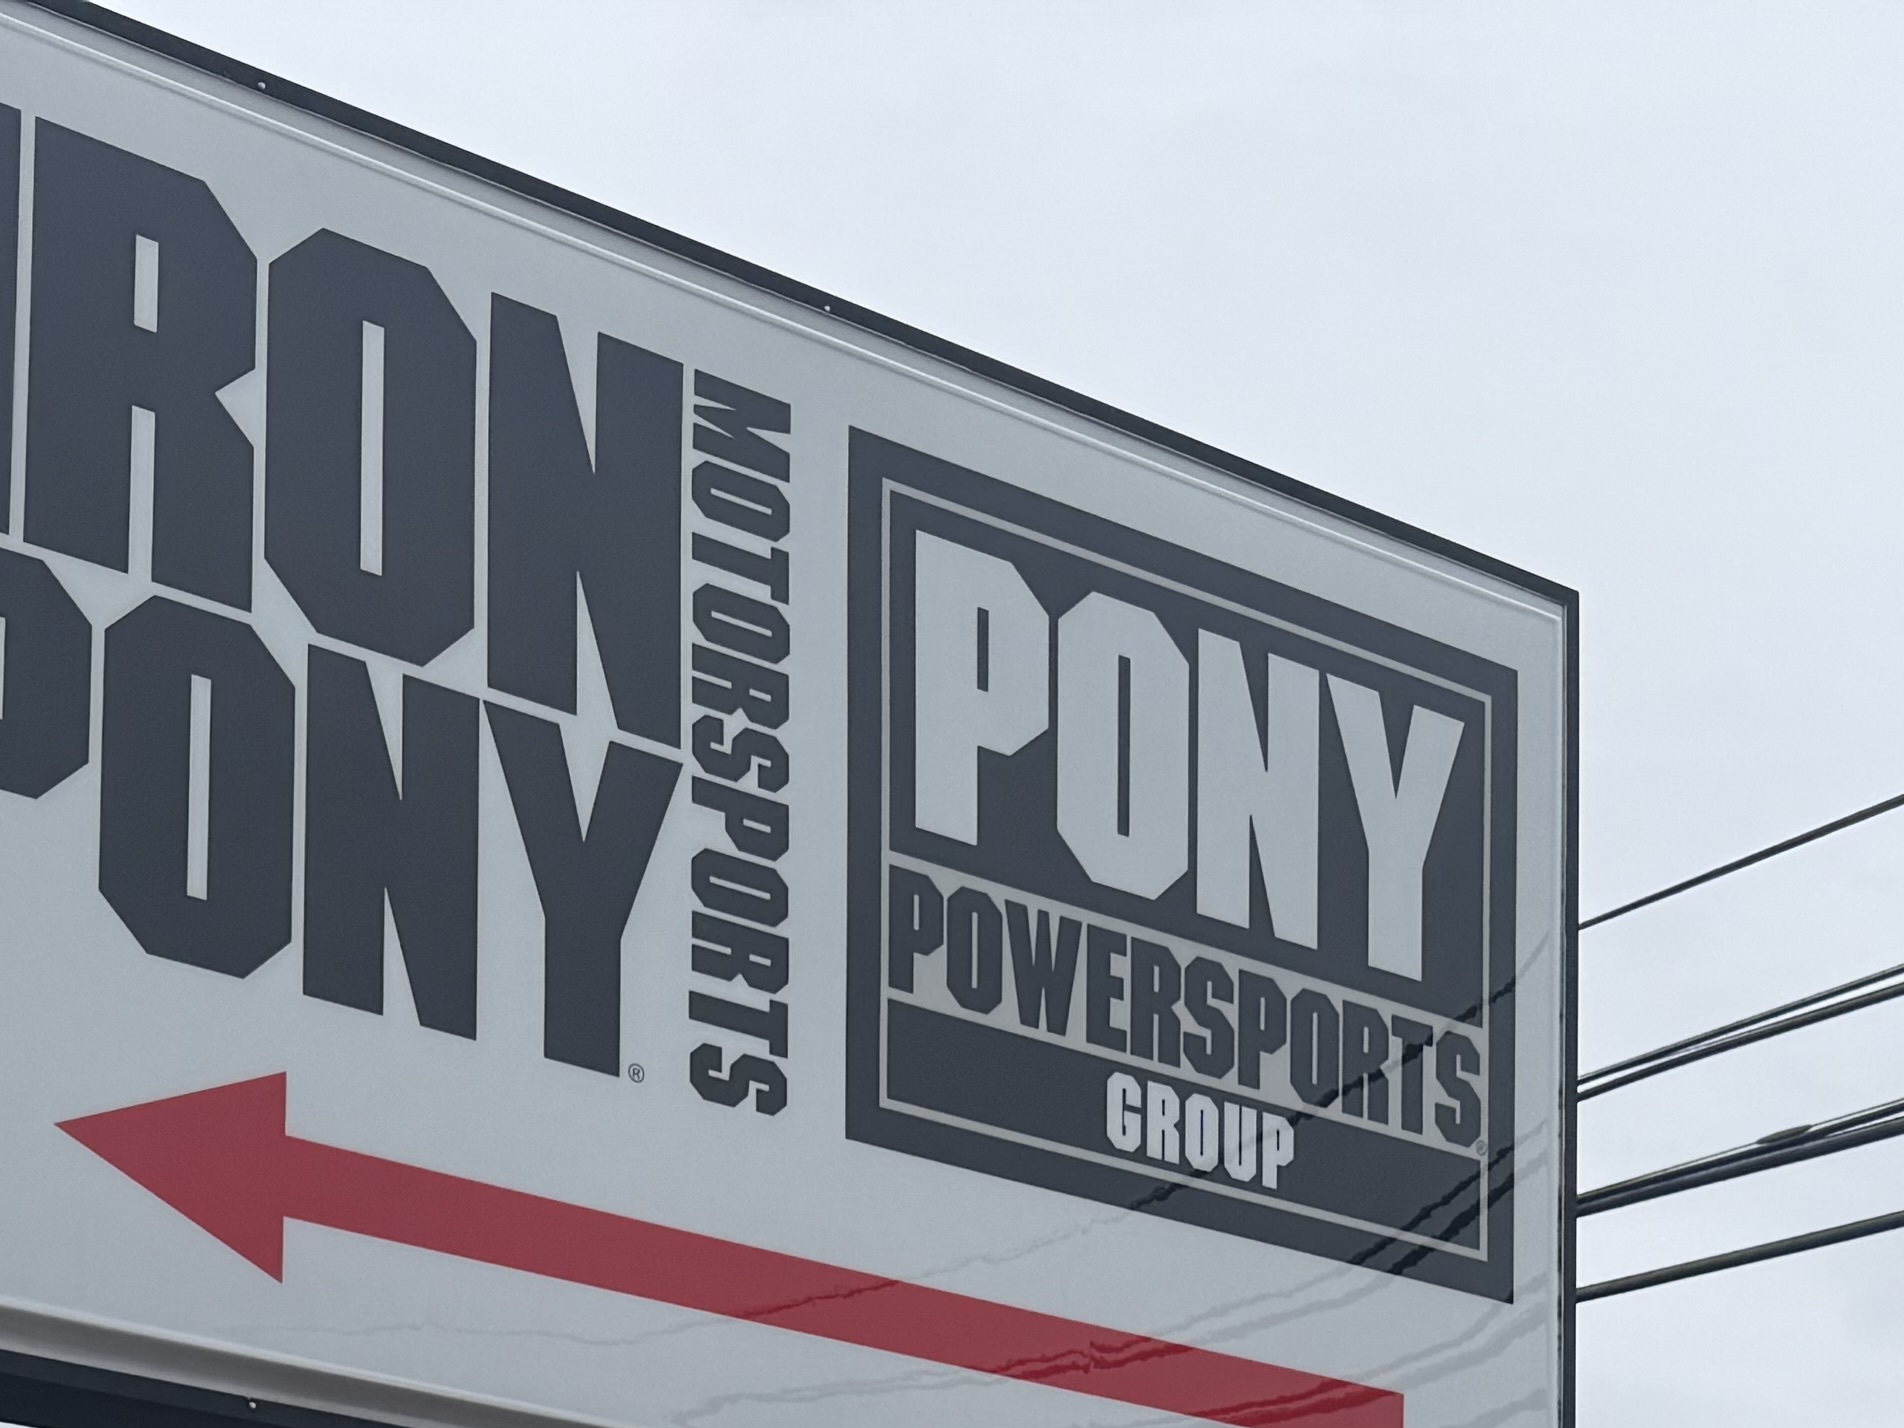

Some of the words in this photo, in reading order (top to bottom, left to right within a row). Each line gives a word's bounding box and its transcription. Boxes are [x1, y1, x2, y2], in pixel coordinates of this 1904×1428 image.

[688, 368, 792, 1116] MOTORSPORTS
[914, 529, 1466, 982] PONY
[887, 863, 1482, 1148] POWERSPORTS
[1106, 1071, 1294, 1190] GROUP
